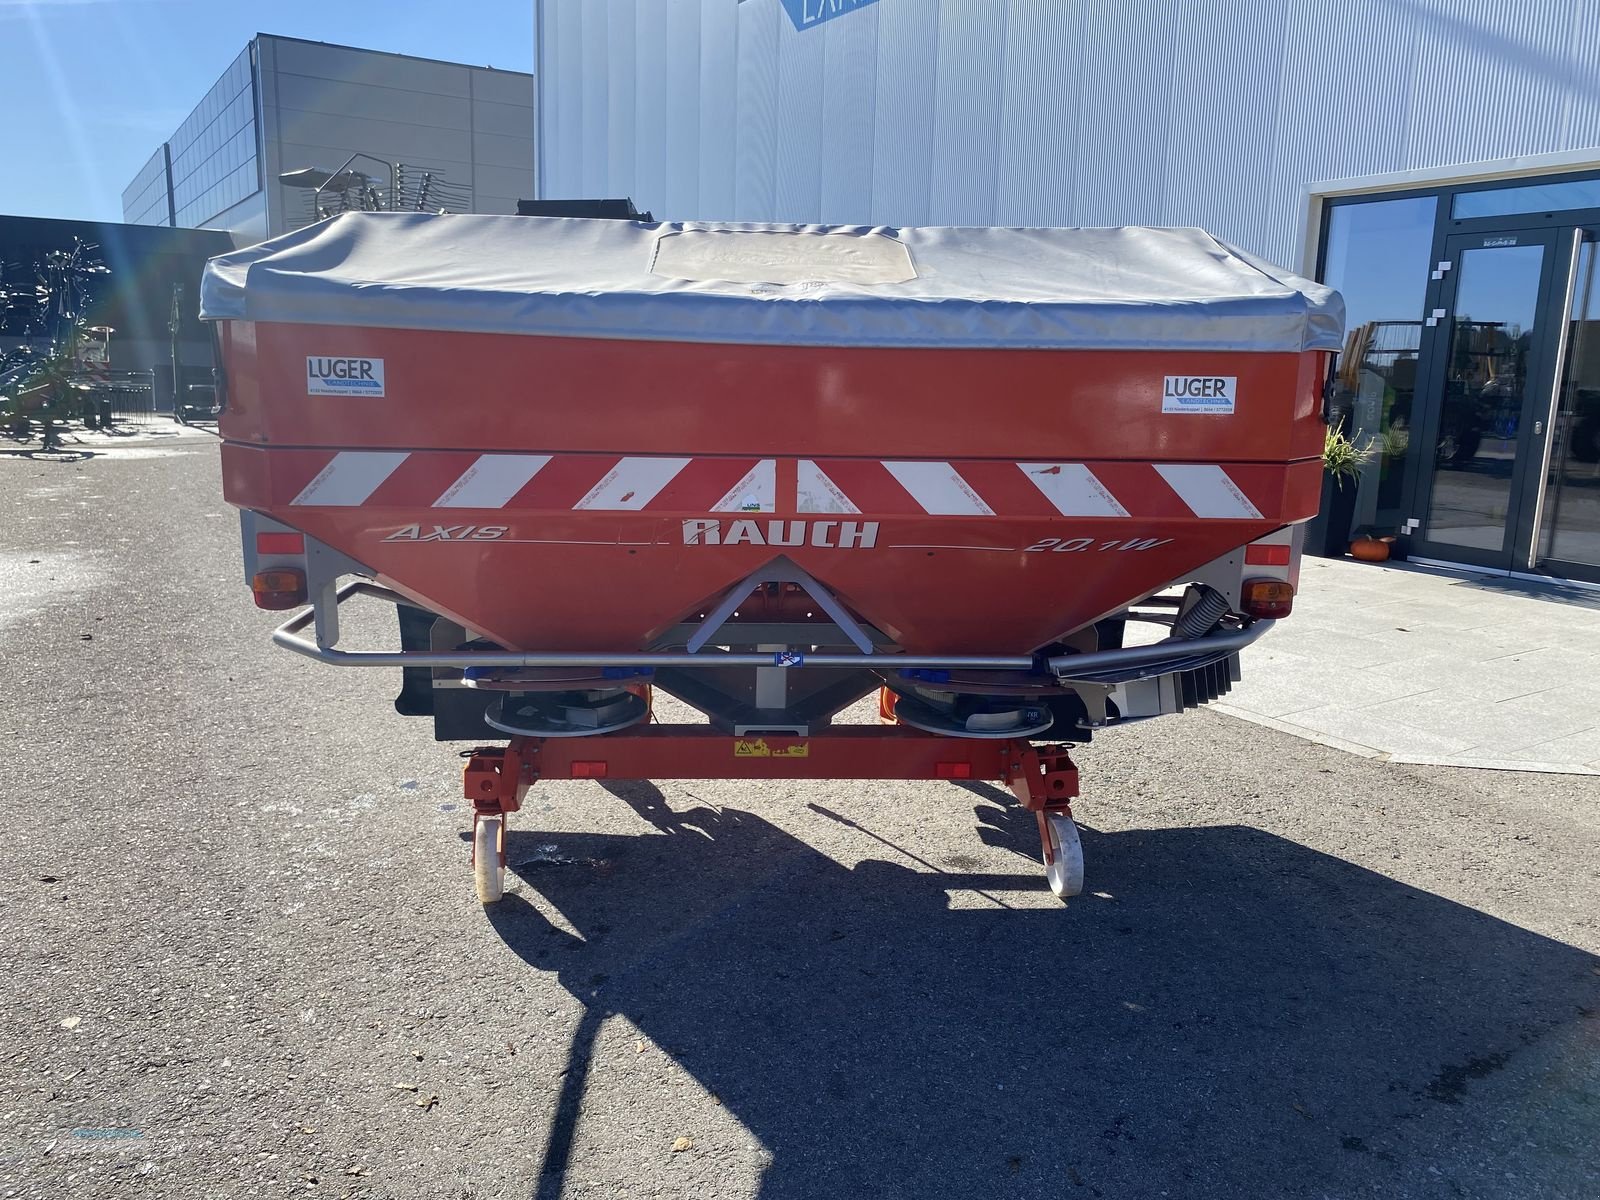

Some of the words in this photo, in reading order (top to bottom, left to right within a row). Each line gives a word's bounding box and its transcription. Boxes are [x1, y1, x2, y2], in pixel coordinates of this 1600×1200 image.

[309, 359, 374, 379] LUGER
[1165, 378, 1226, 397] LUGER
[385, 524, 509, 540] AXIS
[682, 519, 880, 548] RAUCH
